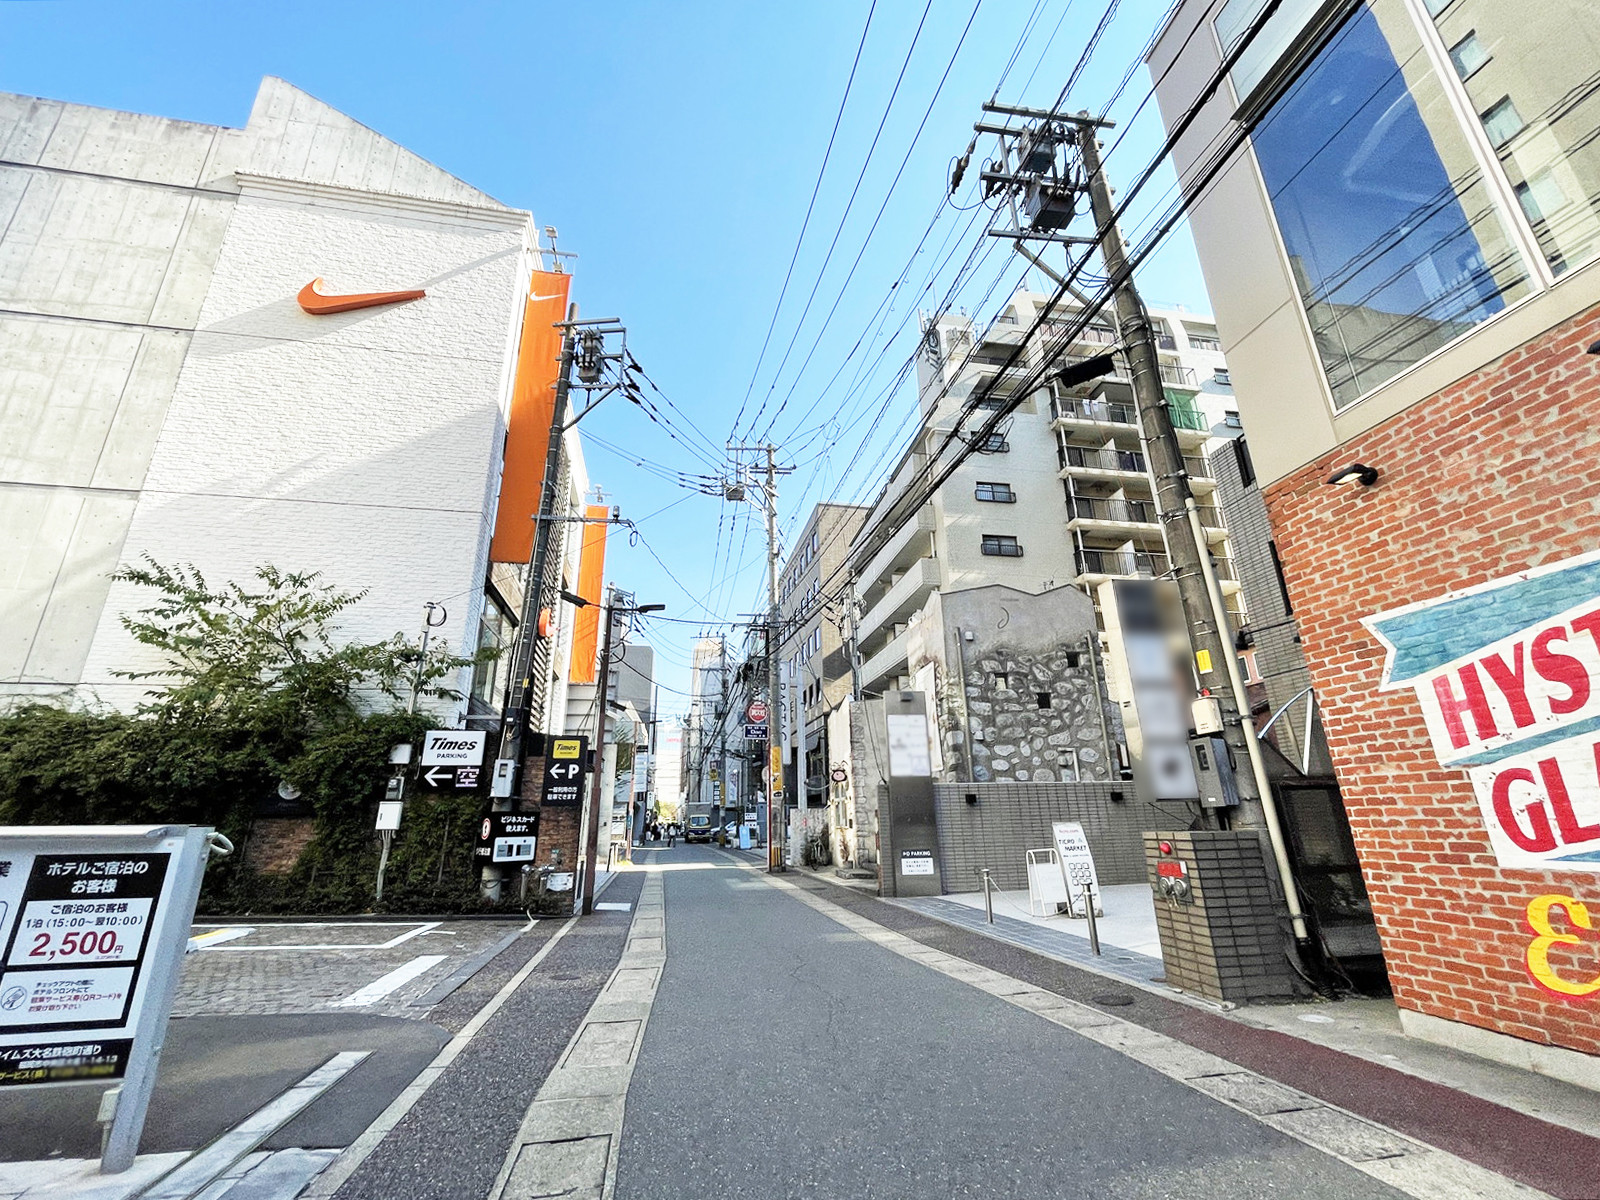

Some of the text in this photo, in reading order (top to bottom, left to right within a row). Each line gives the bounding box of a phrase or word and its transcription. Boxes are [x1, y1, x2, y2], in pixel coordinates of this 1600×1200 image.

[430, 737, 478, 751] Times
[556, 743, 577, 751] Times
[455, 766, 480, 788] 空
[567, 763, 580, 779] P
[1492, 742, 1600, 853] GL
[500, 815, 536, 824] ビジネスカード
[46, 861, 149, 876] ホテルご宿泊の
[70, 878, 118, 894] お客様
[50, 903, 129, 915] ご宿泊のお客様
